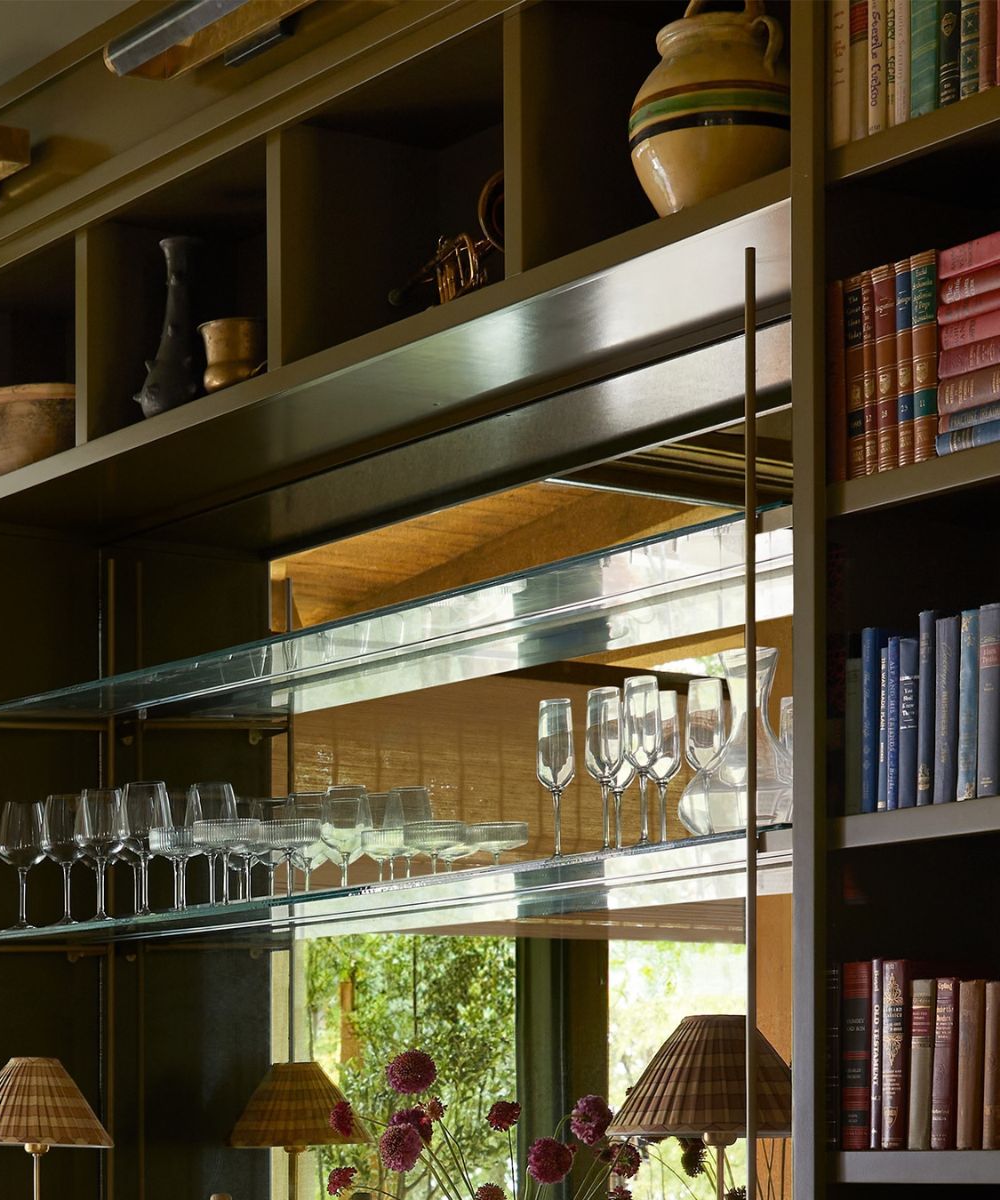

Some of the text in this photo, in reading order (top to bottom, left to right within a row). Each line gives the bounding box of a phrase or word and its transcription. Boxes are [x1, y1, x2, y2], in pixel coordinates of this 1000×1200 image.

[871, 11, 883, 59] Sterile
[870, 64, 881, 107] Cuckoo
[871, 1028, 879, 1086] TESTAMENT
